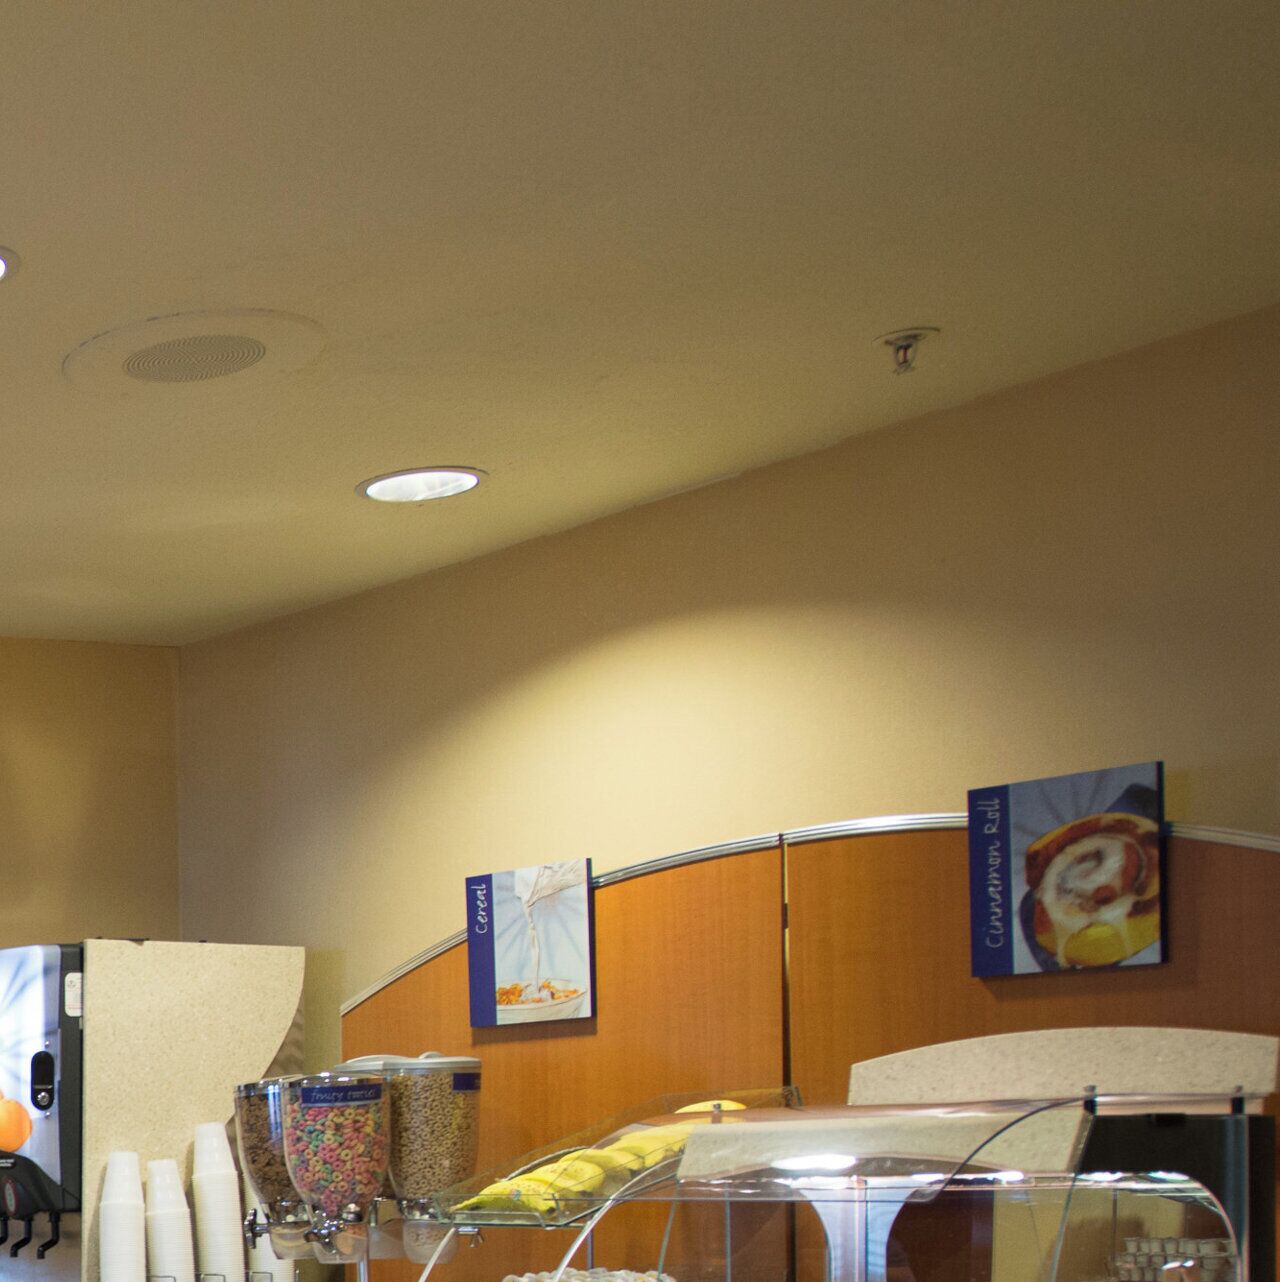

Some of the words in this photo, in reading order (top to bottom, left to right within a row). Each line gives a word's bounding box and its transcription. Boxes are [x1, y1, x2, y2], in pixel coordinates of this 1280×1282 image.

[977, 797, 1001, 834] Roll
[471, 882, 489, 934] Cereal
[985, 841, 1005, 950] Cinnamon
